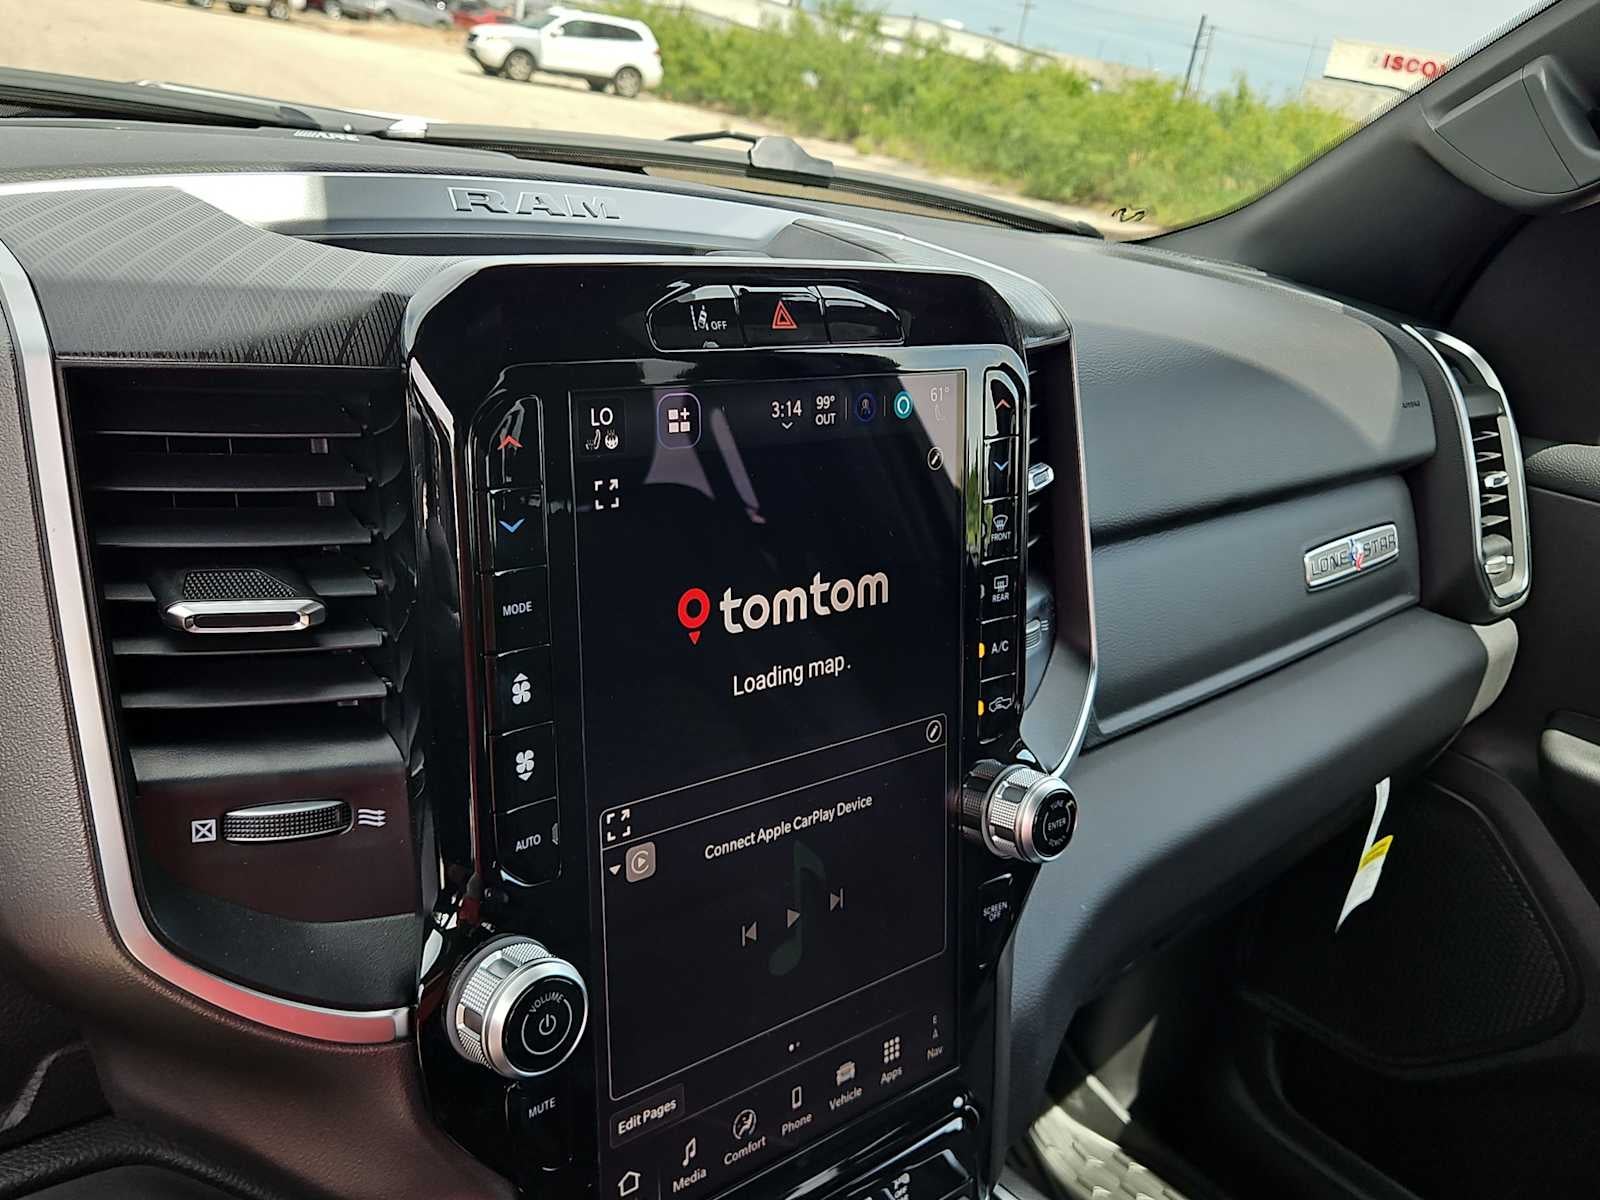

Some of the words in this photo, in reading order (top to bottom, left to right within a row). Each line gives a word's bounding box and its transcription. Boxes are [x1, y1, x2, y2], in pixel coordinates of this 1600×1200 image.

[447, 186, 621, 220] RAM
[710, 320, 728, 331] OFF
[771, 400, 802, 418] 3:14
[815, 394, 836, 410] 99°
[590, 407, 614, 427] LO
[814, 412, 836, 426] OUT
[991, 531, 1012, 542] FRONT
[1311, 549, 1349, 576] LONE
[1363, 534, 1397, 557] STAR
[719, 571, 889, 634] tomtom
[992, 592, 1010, 603] REAR
[502, 601, 533, 617] MODE
[991, 639, 1010, 655] A/C
[733, 664, 804, 697] Loading
[807, 655, 852, 679] map.
[704, 833, 756, 860] Connect
[757, 820, 792, 844] Apple
[793, 806, 835, 830] CarPlay
[837, 795, 873, 817] Device
[1047, 817, 1067, 832] ENTER
[514, 834, 542, 852] AUTO
[983, 901, 1009, 917] SCREEN
[529, 992, 564, 1012] VOLUME
[926, 1046, 944, 1061] Nav
[880, 1066, 903, 1085] Apps
[528, 1097, 557, 1119] MUTE
[828, 1086, 863, 1111] Vehicle
[617, 1118, 643, 1136] Edit
[643, 1099, 677, 1124] Pages
[781, 1112, 813, 1137] Phone
[723, 1135, 768, 1166] Comfort
[671, 1167, 708, 1193] Media
